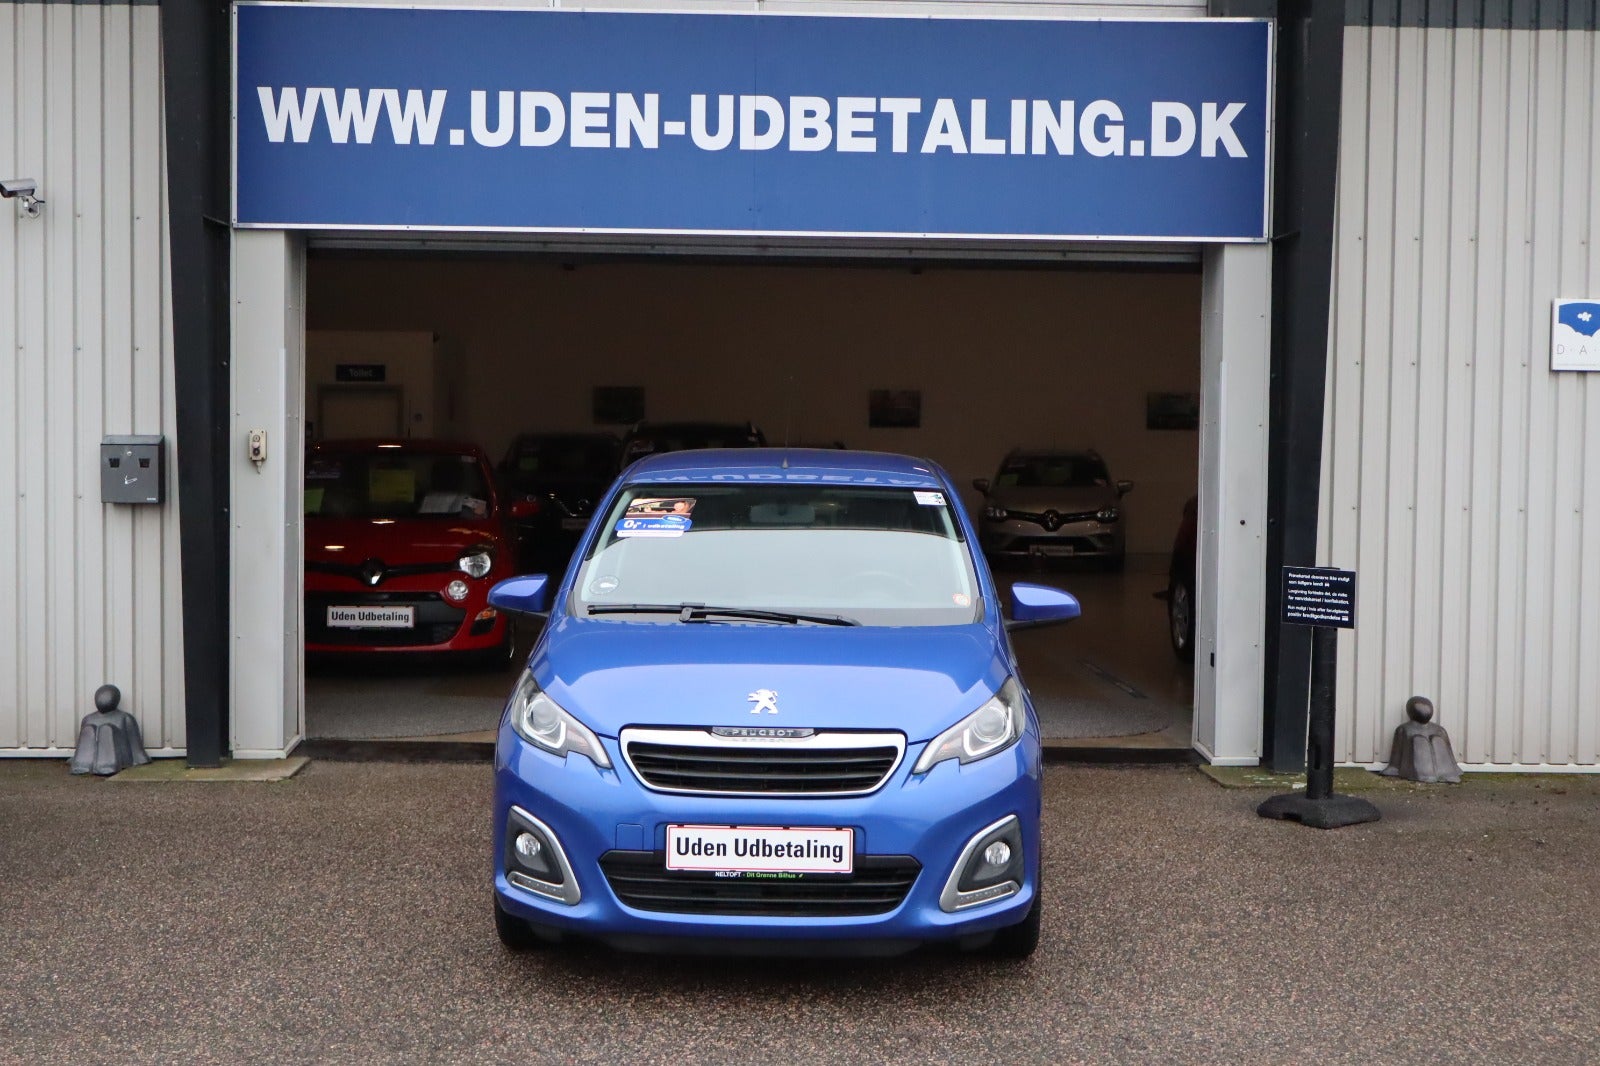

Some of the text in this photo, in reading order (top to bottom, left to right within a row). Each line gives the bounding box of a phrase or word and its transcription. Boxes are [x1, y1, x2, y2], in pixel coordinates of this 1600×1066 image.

[257, 86, 1248, 159] WWW.UDEN-UDBETALING.DK
[331, 611, 410, 623] Uden Udbetaling
[676, 836, 844, 863] Uden Udbetaling
